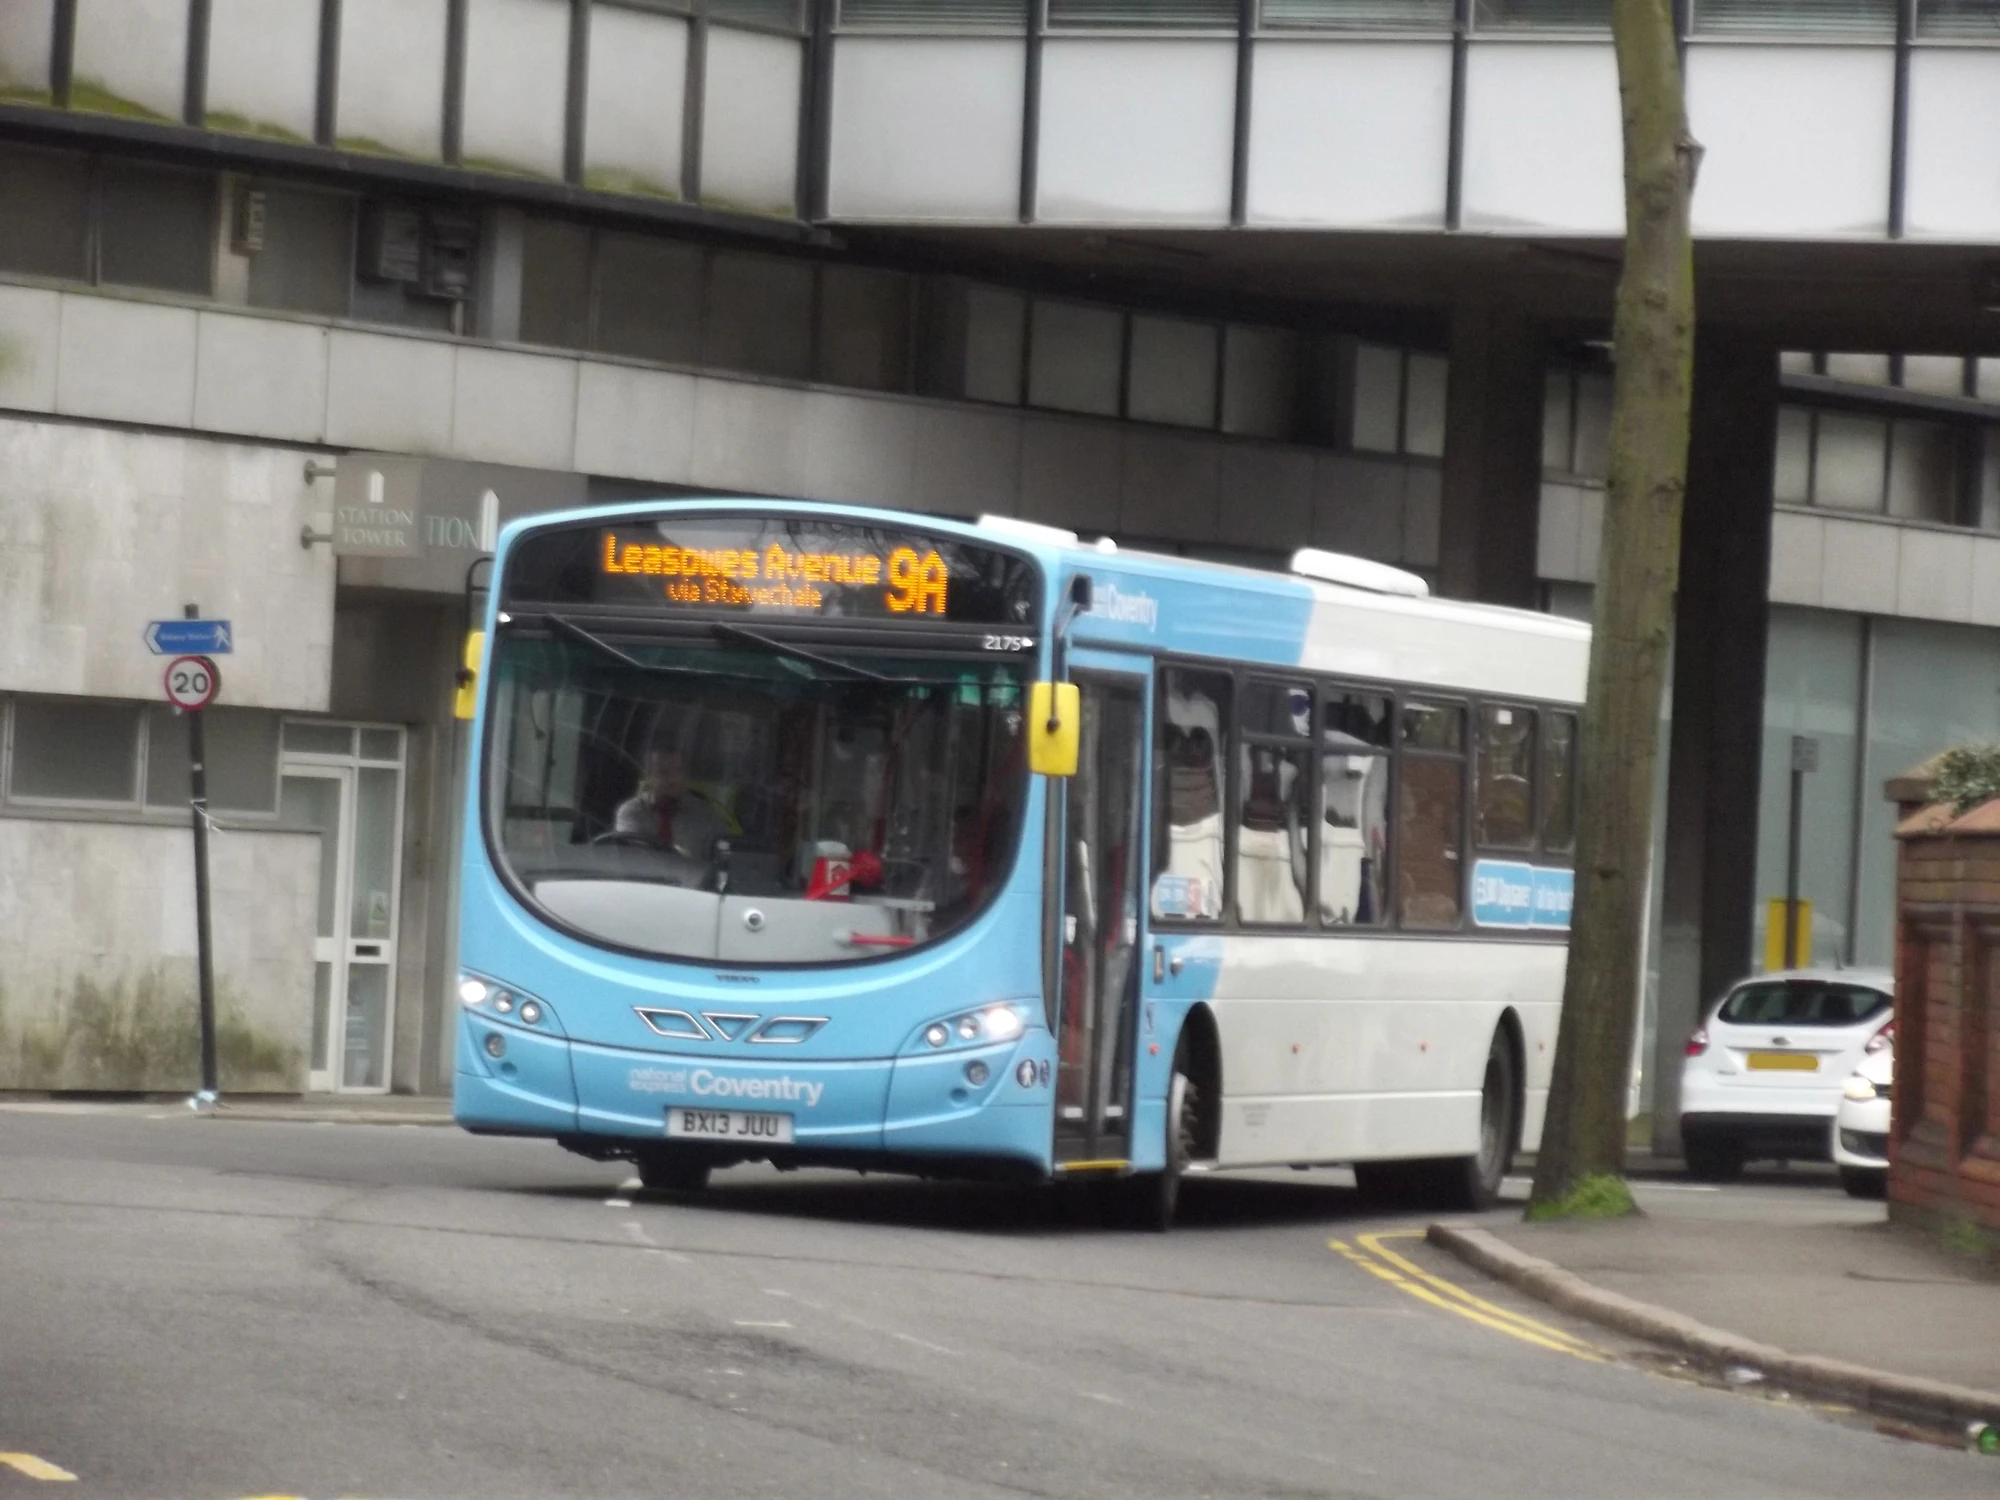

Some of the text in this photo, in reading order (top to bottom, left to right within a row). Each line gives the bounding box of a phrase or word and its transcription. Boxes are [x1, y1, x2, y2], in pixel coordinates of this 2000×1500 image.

[337, 508, 414, 526] STATION
[342, 528, 407, 547] TOWER
[766, 541, 881, 585] Avenue
[668, 577, 701, 603] via
[886, 546, 948, 613] 9A
[983, 635, 1022, 651] 2175
[173, 671, 209, 695] 20
[690, 1068, 825, 1107] Coventry
[682, 1111, 779, 1137] BX13 JUU
